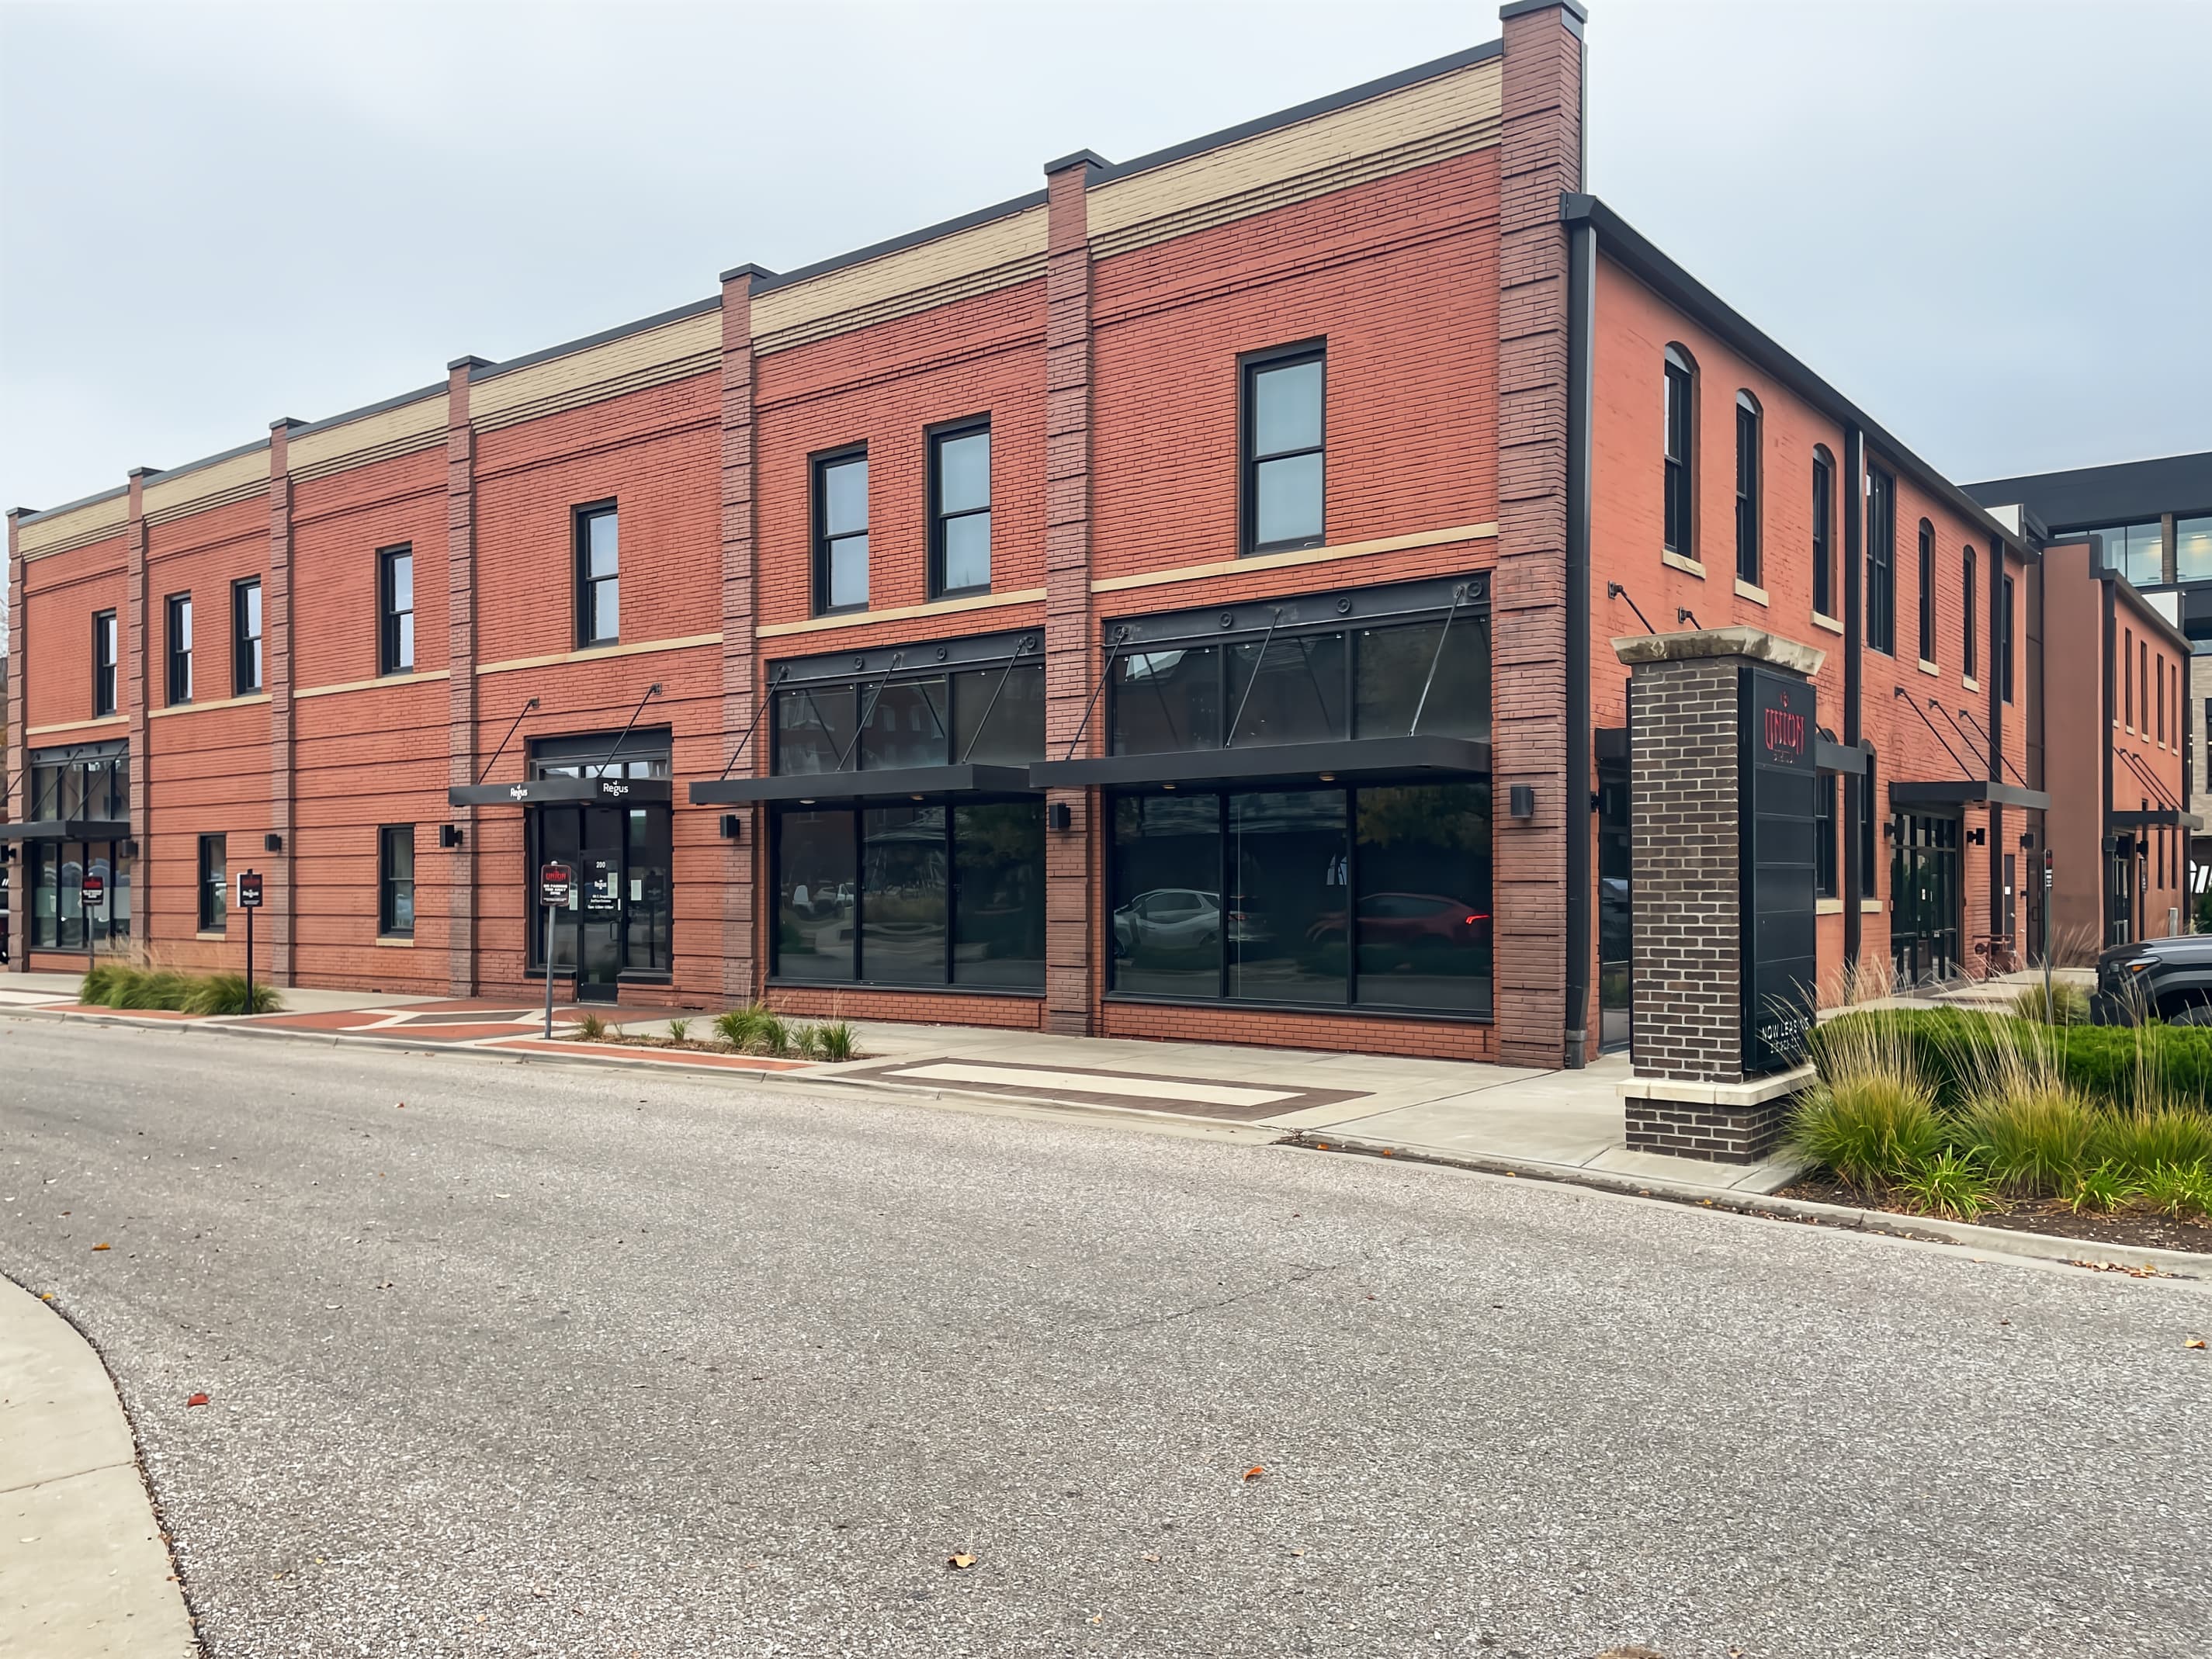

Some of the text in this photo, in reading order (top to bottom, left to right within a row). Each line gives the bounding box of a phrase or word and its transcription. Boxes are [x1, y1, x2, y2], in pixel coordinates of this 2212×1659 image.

[1764, 708, 1805, 755] UNION
[511, 784, 528, 801] Regus
[603, 780, 629, 797] Regus
[1762, 1017, 1809, 1040] NOW LEASNG
